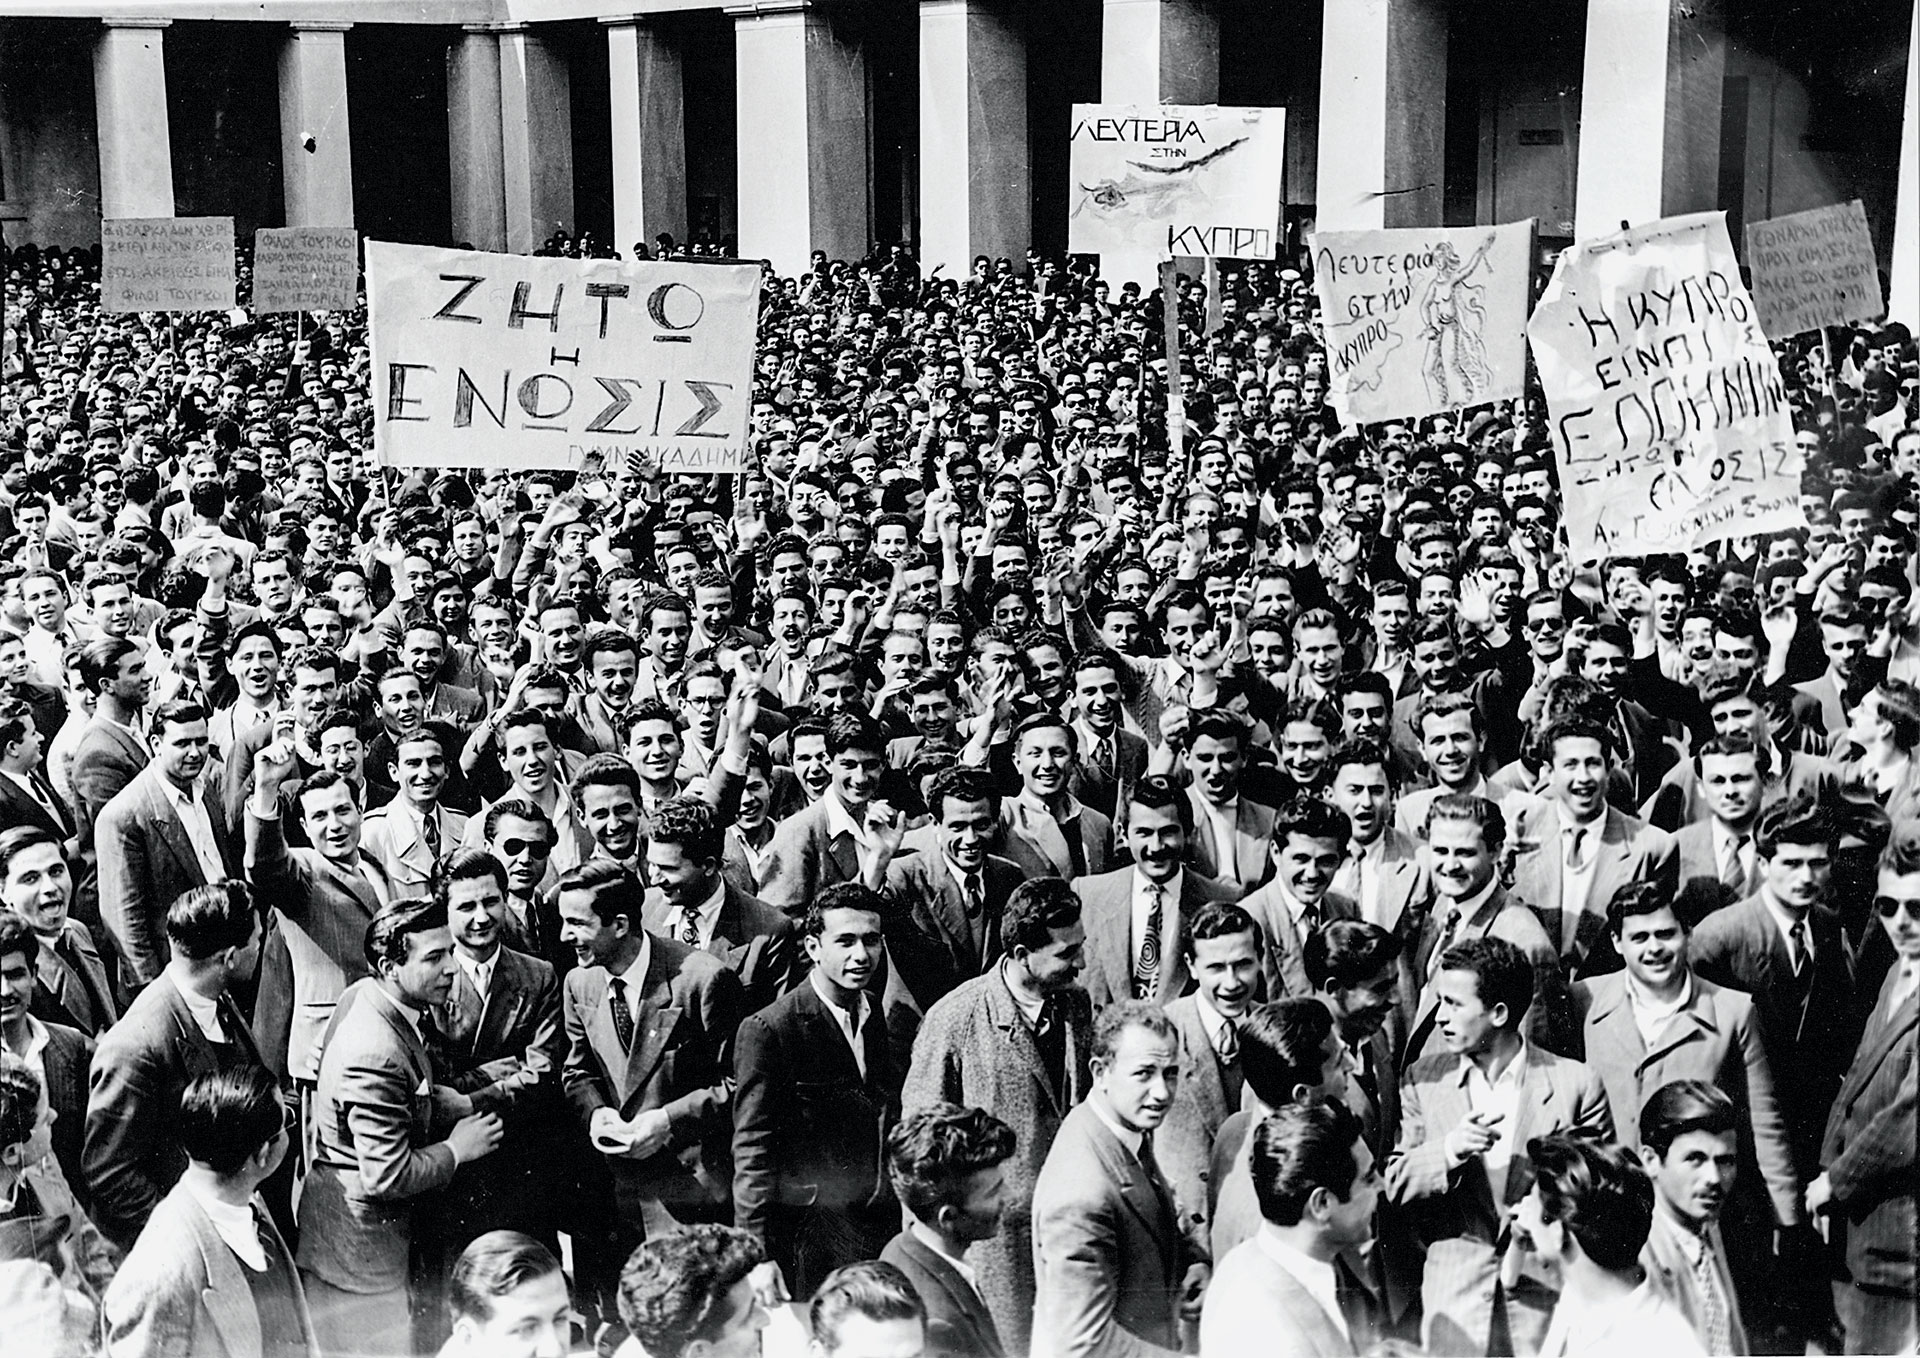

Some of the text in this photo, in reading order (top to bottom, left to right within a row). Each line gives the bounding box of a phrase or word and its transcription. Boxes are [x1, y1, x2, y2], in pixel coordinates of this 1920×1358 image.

[1070, 118, 1206, 143] ΛΕΥΤΕΡΙΑ
[1149, 148, 1187, 158] ΣΤΗΝ
[1168, 225, 1270, 257] ΚΥΠΡΟ
[432, 272, 706, 343] ΖΗΤΩ
[1578, 302, 1620, 348] Η
[550, 345, 580, 367] Η
[386, 362, 734, 438] ΕΝΩΣΙΣ
